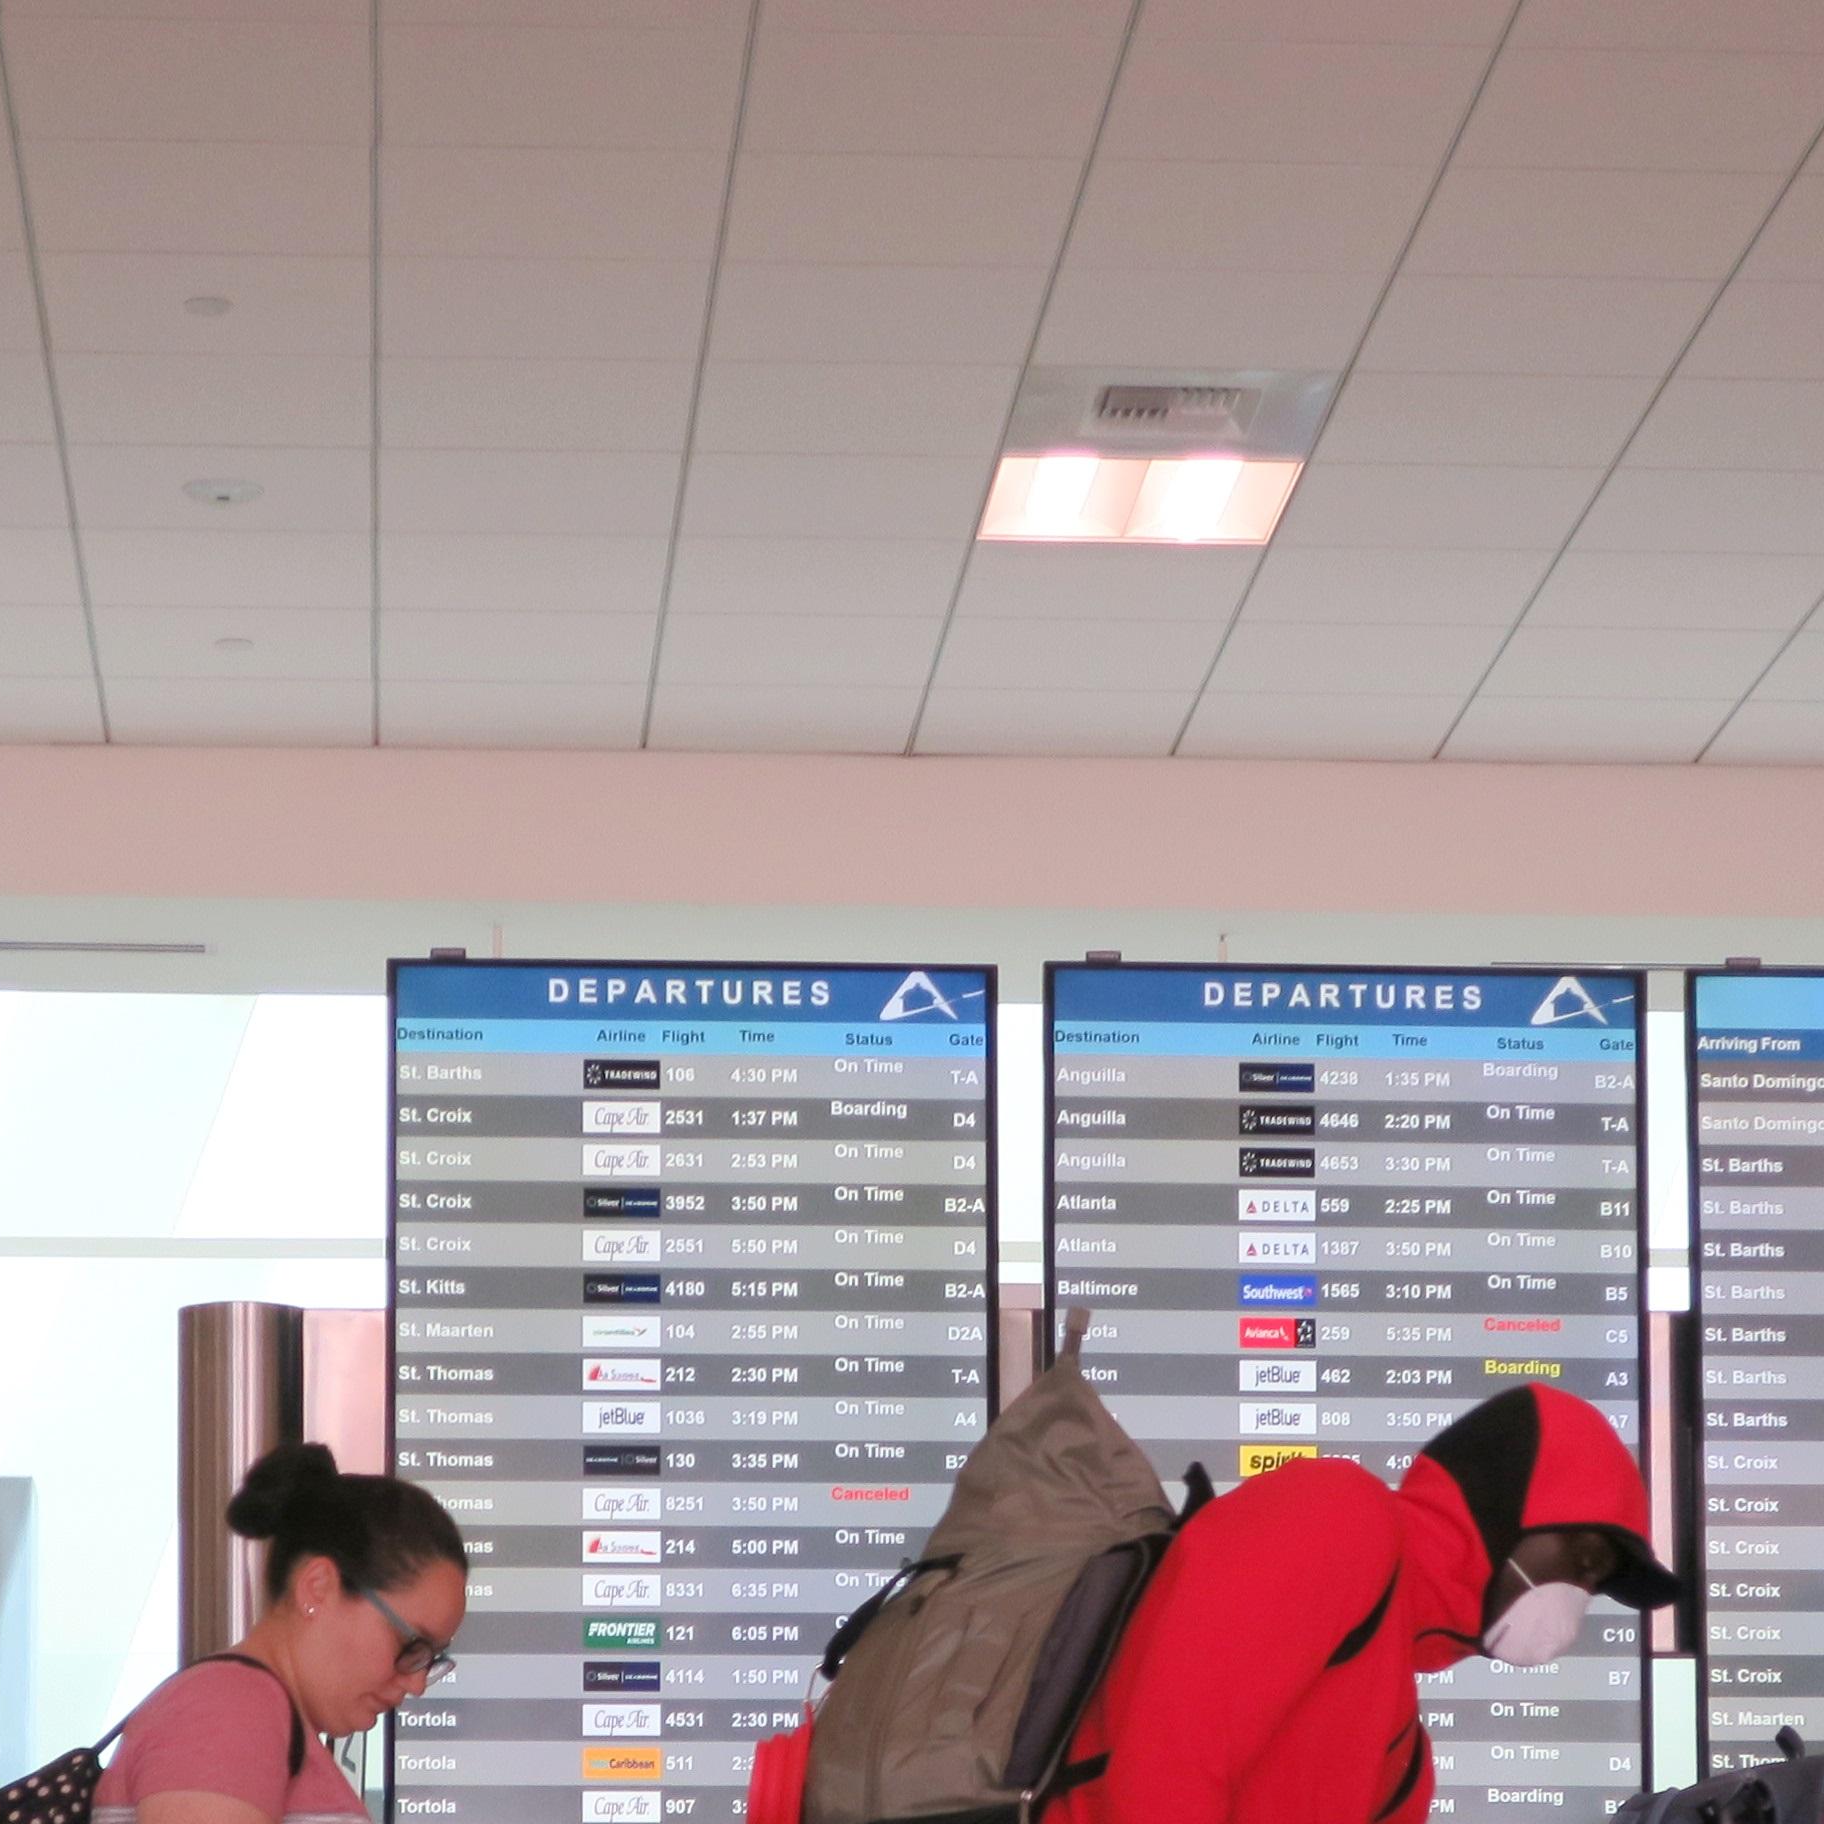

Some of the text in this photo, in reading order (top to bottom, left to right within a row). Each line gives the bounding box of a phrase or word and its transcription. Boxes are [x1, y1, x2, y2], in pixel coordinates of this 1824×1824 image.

[549, 978, 829, 1006] DEPARTURES
[1204, 982, 1481, 1010] DEPARTURES
[397, 1027, 483, 1040] Destination
[597, 1029, 646, 1042] Airline
[662, 1030, 705, 1045] Flight
[739, 1030, 774, 1042] Time
[846, 1033, 893, 1046] Status
[949, 1033, 983, 1046] Gate
[1054, 1029, 1140, 1045] Destination
[1252, 1032, 1300, 1045] Airline
[1392, 1033, 1427, 1046] Time
[1316, 1034, 1358, 1050] Flight
[1497, 1037, 1544, 1050] Status
[1599, 1038, 1634, 1051] Gate
[1697, 1036, 1800, 1053] Arriving From
[1700, 1073, 1748, 1088] Santo
[399, 1107, 472, 1123] St. Croix
[831, 1100, 907, 1119] Boarding
[1486, 1105, 1555, 1120] On Time
[593, 1107, 624, 1132] Cape
[665, 1110, 703, 1125] 2531
[732, 1110, 797, 1126] 1:37 PM
[954, 1112, 976, 1127] D4
[1057, 1110, 1126, 1128] Anguilla
[1260, 1116, 1312, 1126] TRADEWIND
[1319, 1113, 1359, 1128] 4646
[1385, 1114, 1450, 1129] 2:20 PM
[1601, 1117, 1629, 1132] T-A
[1702, 1158, 1783, 1173] St. Barths
[399, 1193, 471, 1209] St. Croix
[835, 1186, 904, 1201] On Time
[1487, 1189, 1555, 1204] On Time
[666, 1195, 705, 1210] 3952
[732, 1196, 798, 1211] 3:50 PM
[945, 1198, 985, 1213] B2-A
[1057, 1195, 1116, 1210] Atlanta
[1262, 1200, 1309, 1213] DELTA
[1321, 1198, 1349, 1213] 559
[1385, 1199, 1451, 1214] 2:25 PM
[1601, 1202, 1629, 1216] B11
[1703, 1242, 1785, 1257] St. Barths
[399, 1279, 465, 1294] St. Kitts
[835, 1272, 904, 1287] On Time
[665, 1281, 705, 1296] 4180
[732, 1281, 798, 1297] 5:15 PM
[945, 1283, 985, 1298] B2-A
[1058, 1281, 1138, 1295] Baltimore
[1243, 1284, 1305, 1300] Southwest
[1321, 1283, 1360, 1298] 1565
[1386, 1284, 1451, 1299] 3:10 PM
[1605, 1287, 1628, 1301] B5
[1484, 1317, 1562, 1332] Canceled
[1244, 1327, 1279, 1339] Avianca
[835, 1357, 904, 1372] On Time
[1485, 1360, 1560, 1378] Boarding
[399, 1365, 494, 1381] St. Thomas
[665, 1367, 695, 1382] 212
[732, 1367, 798, 1383] 2:30 PM
[951, 1369, 980, 1384] T-A
[1255, 1365, 1301, 1387] jetBlue
[1321, 1369, 1350, 1383] 462
[1386, 1369, 1452, 1384] 2:03 PM
[1605, 1372, 1628, 1386] A3
[598, 1407, 645, 1429] jetBlue
[831, 1487, 910, 1501] Canceled
[588, 1622, 656, 1639] FRONTIER
[666, 1626, 693, 1640] 121
[732, 1626, 798, 1641] 6:05 PM
[1603, 1628, 1635, 1642] C10
[398, 1711, 456, 1727] Tortola
[665, 1712, 703, 1727] 4531
[732, 1712, 767, 1727] 2:30
[1708, 1710, 1806, 1728] St. Maarten
[1609, 1757, 1631, 1772] D4
[1712, 1754, 1734, 1768] St.
